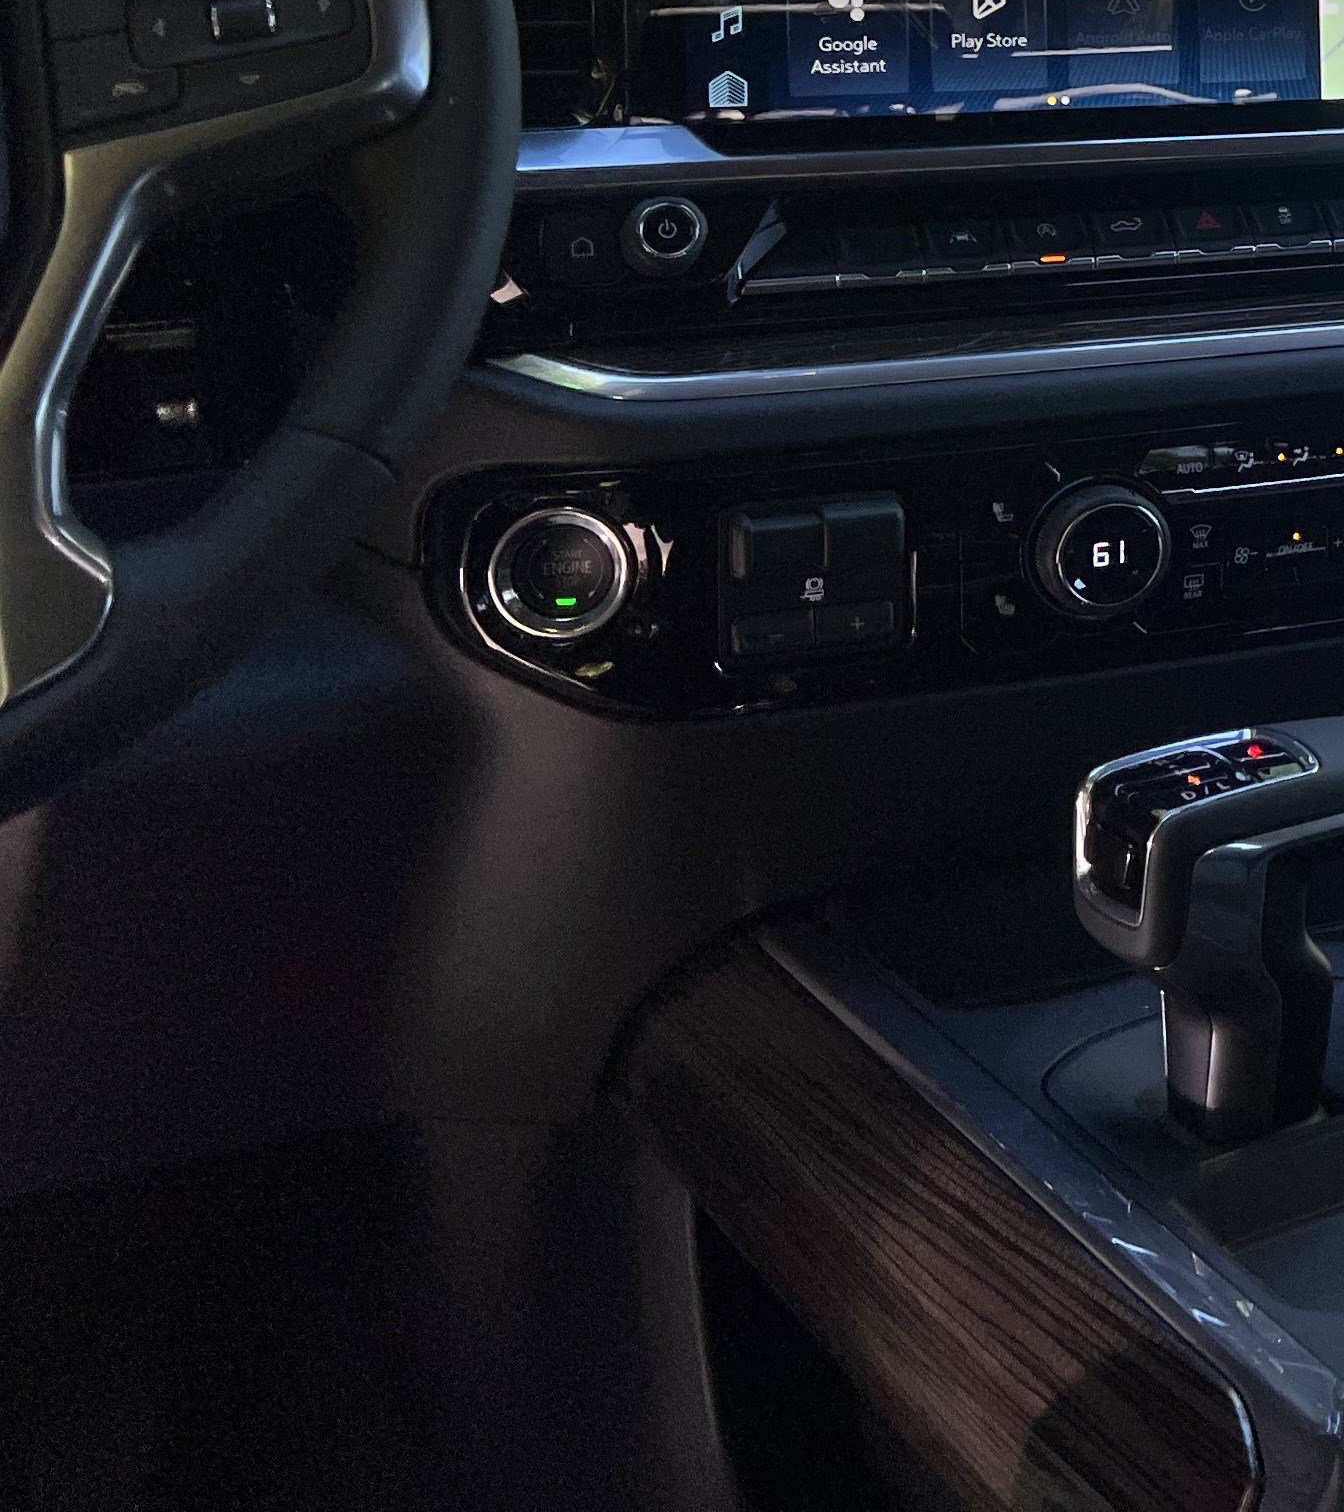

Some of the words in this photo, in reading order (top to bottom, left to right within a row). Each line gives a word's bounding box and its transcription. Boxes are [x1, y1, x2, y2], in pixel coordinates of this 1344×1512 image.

[817, 35, 878, 55] Google
[951, 33, 983, 53] Play
[986, 32, 1028, 48] Store
[810, 58, 887, 75] Assistant
[1176, 462, 1205, 474] AUTO
[1093, 540, 1125, 568] 61
